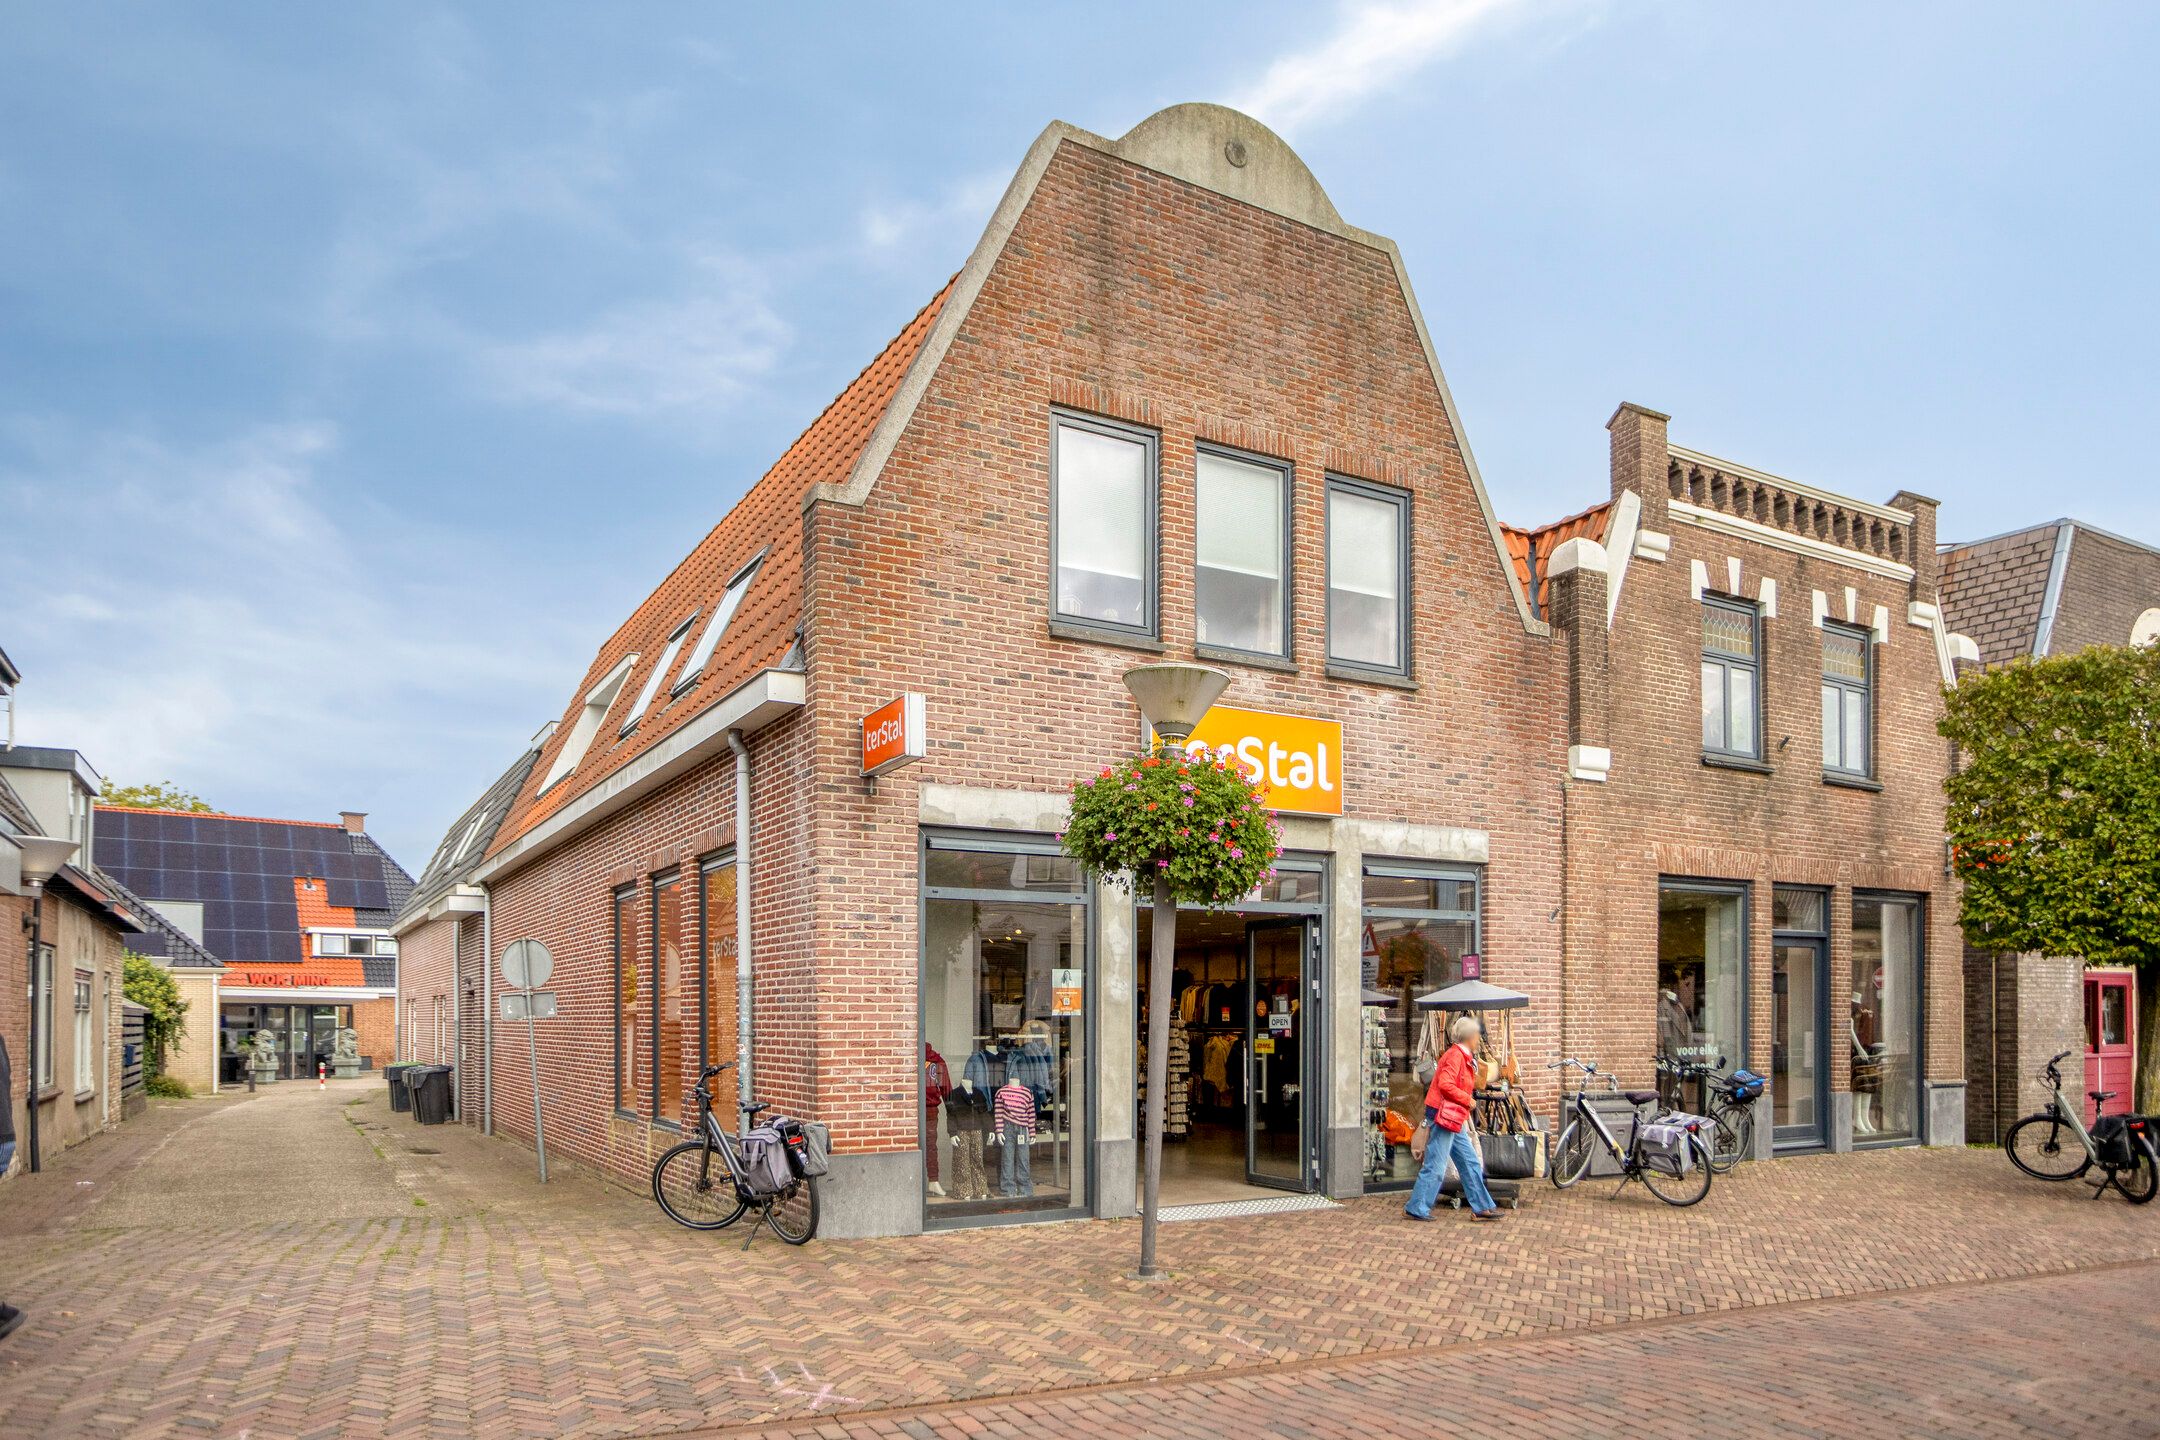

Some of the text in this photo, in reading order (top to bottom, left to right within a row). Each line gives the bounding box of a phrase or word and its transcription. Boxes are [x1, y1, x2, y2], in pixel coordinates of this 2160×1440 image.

[866, 712, 903, 752] terStal
[291, 975, 330, 986] MING
[1271, 1018, 1289, 1026] OPEN
[1676, 1043, 1719, 1056] voor elke
